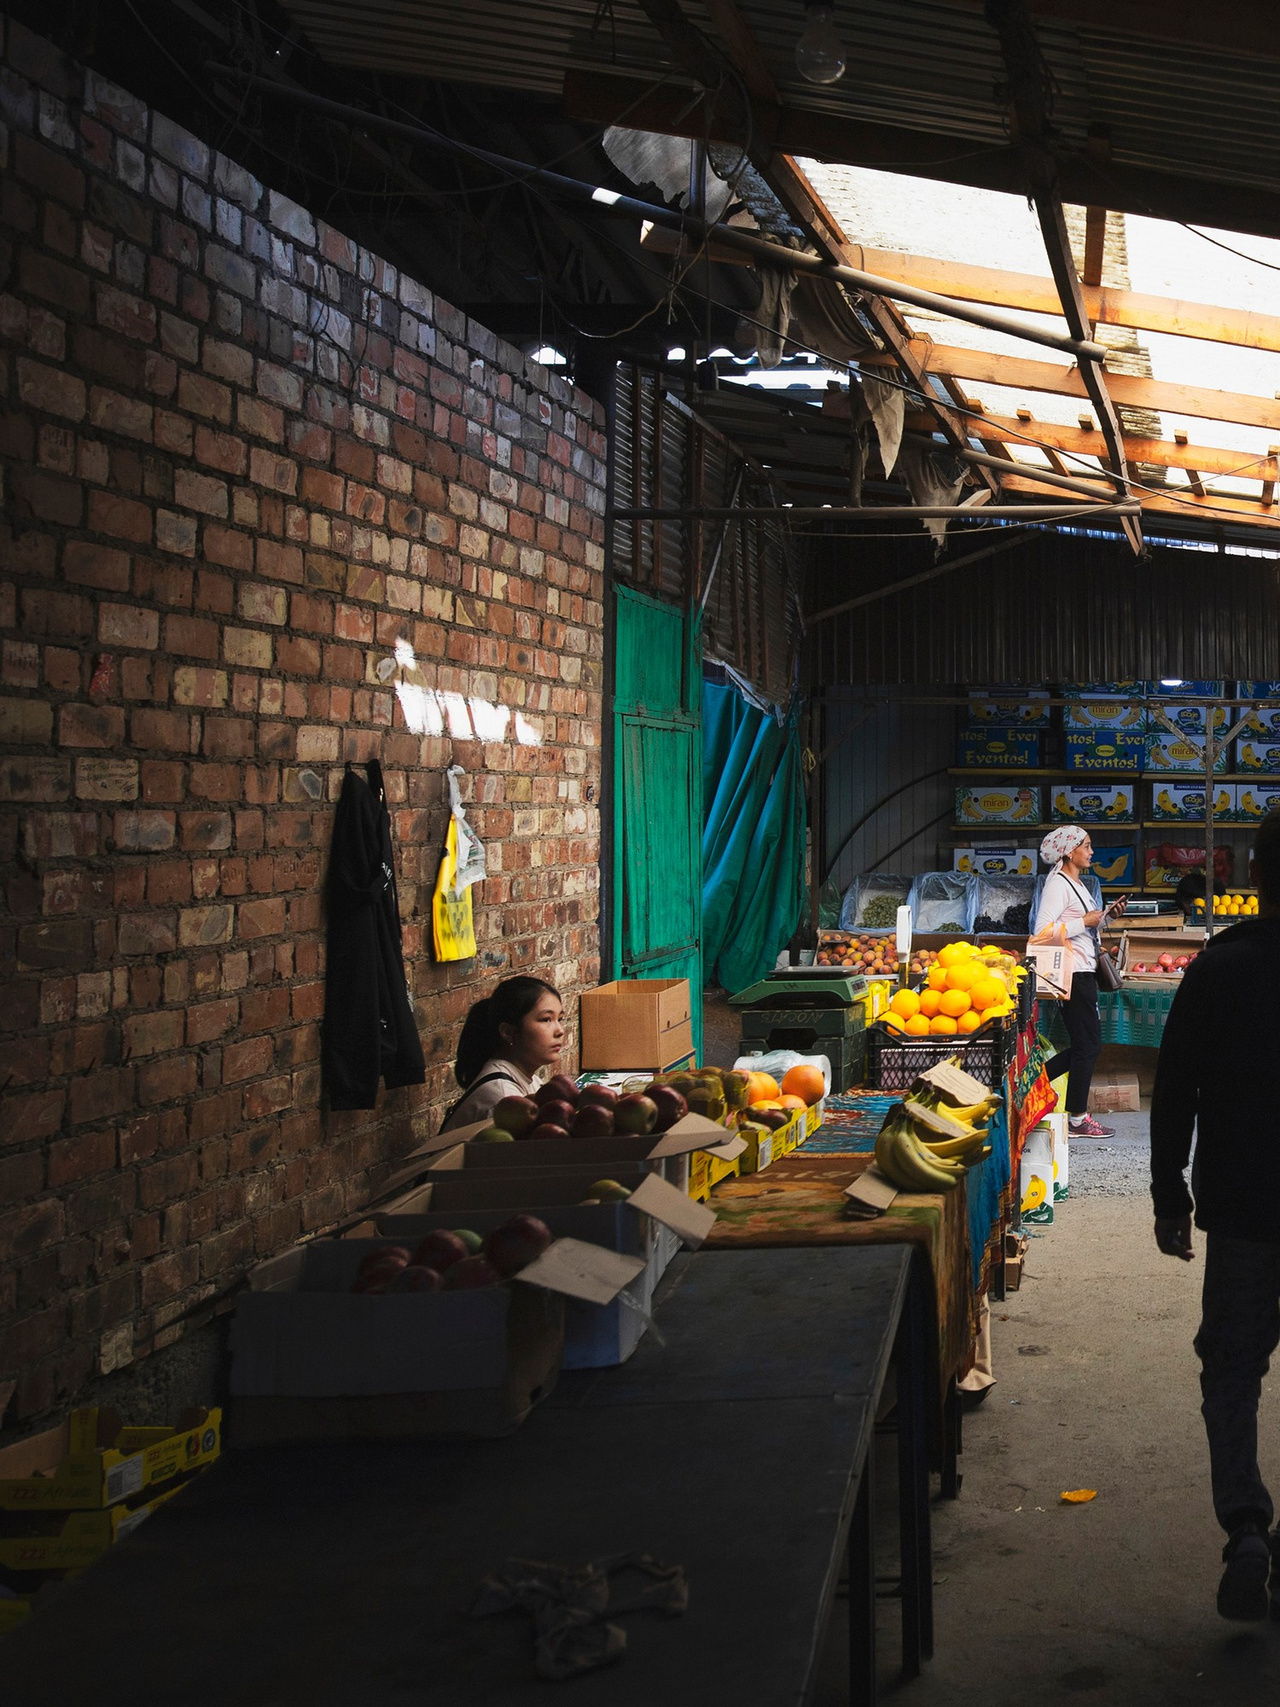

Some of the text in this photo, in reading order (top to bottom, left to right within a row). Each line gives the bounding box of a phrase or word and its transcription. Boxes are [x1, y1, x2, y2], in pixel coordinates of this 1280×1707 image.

[965, 750, 1029, 765] Eventos!
[1074, 754, 1138, 769] Eventos!
[984, 798, 1009, 807] miran
[12, 1487, 38, 1500] ZZ2
